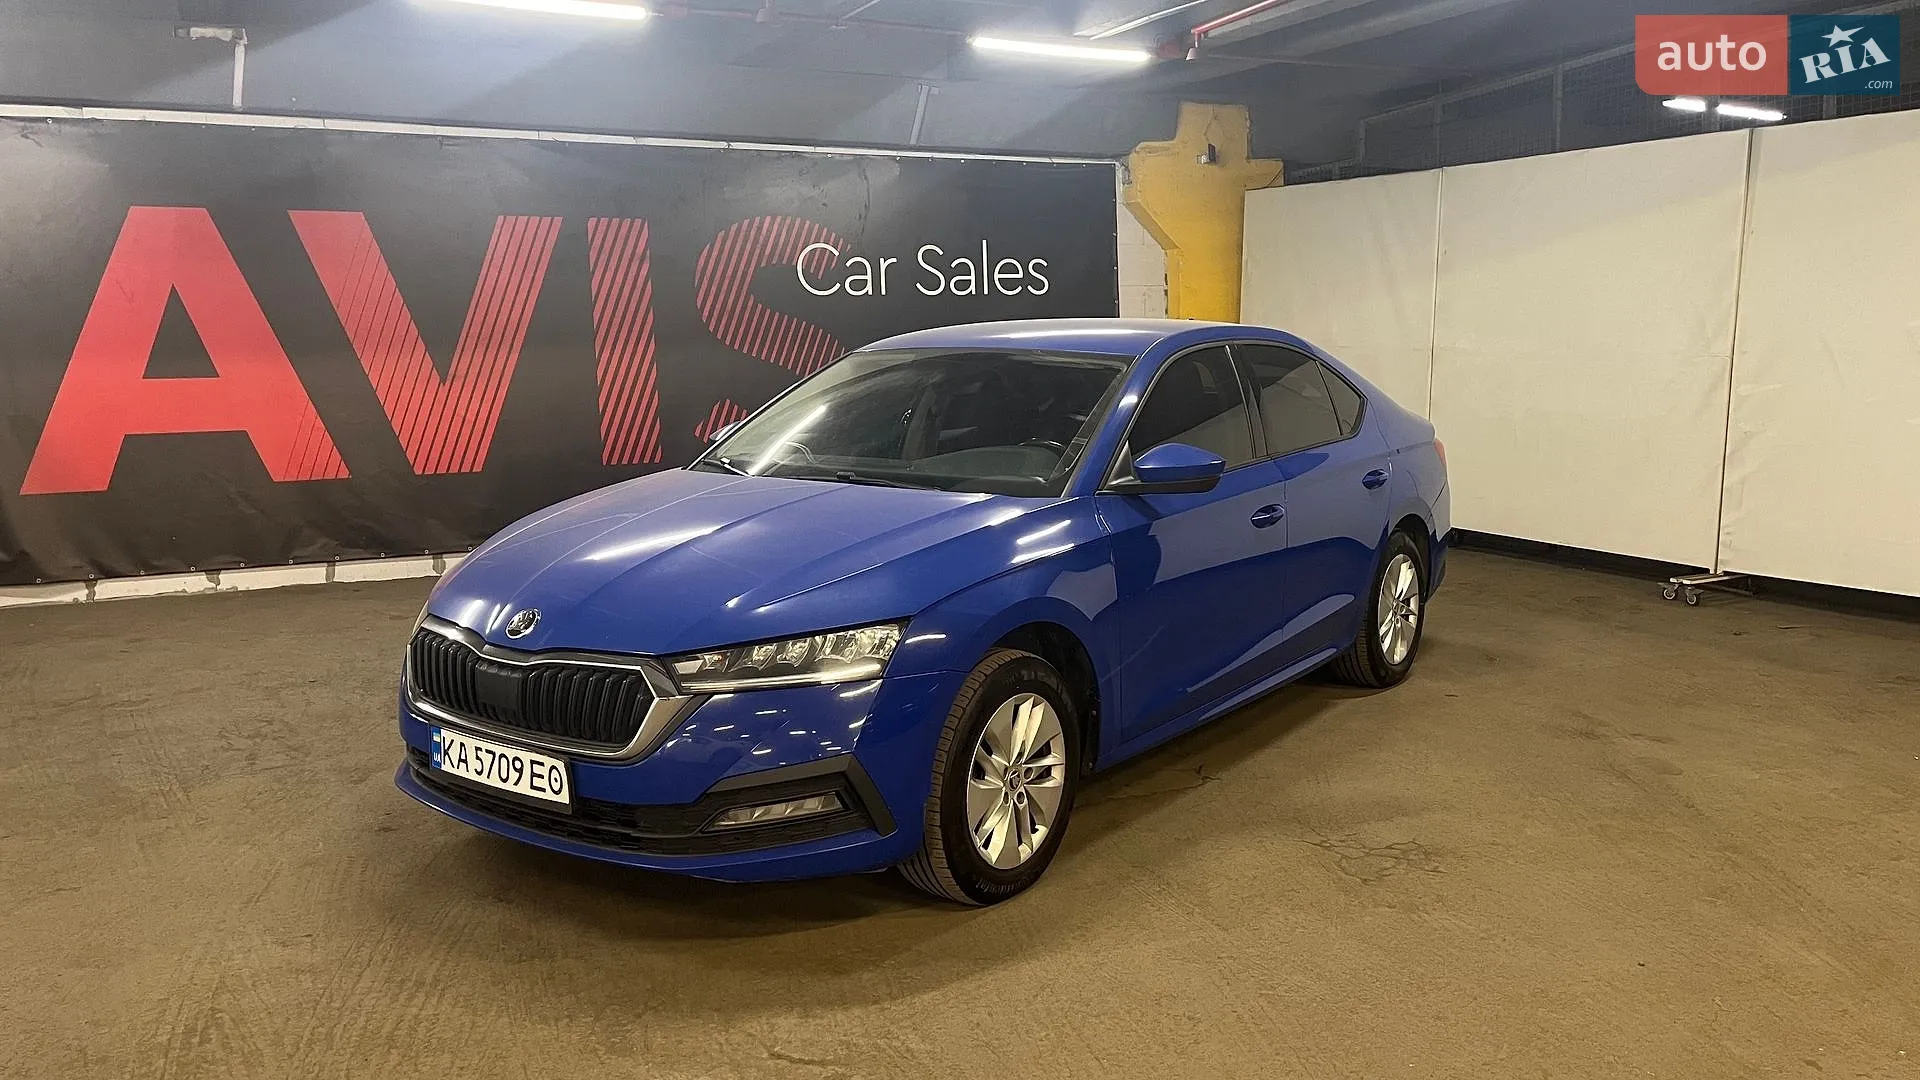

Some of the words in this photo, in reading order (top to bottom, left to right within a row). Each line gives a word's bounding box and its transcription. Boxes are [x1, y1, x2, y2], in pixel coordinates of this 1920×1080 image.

[796, 242, 897, 296] Car
[915, 239, 1050, 296] Sales
[20, 206, 852, 494] AVIS
[474, 746, 524, 786] 5709
